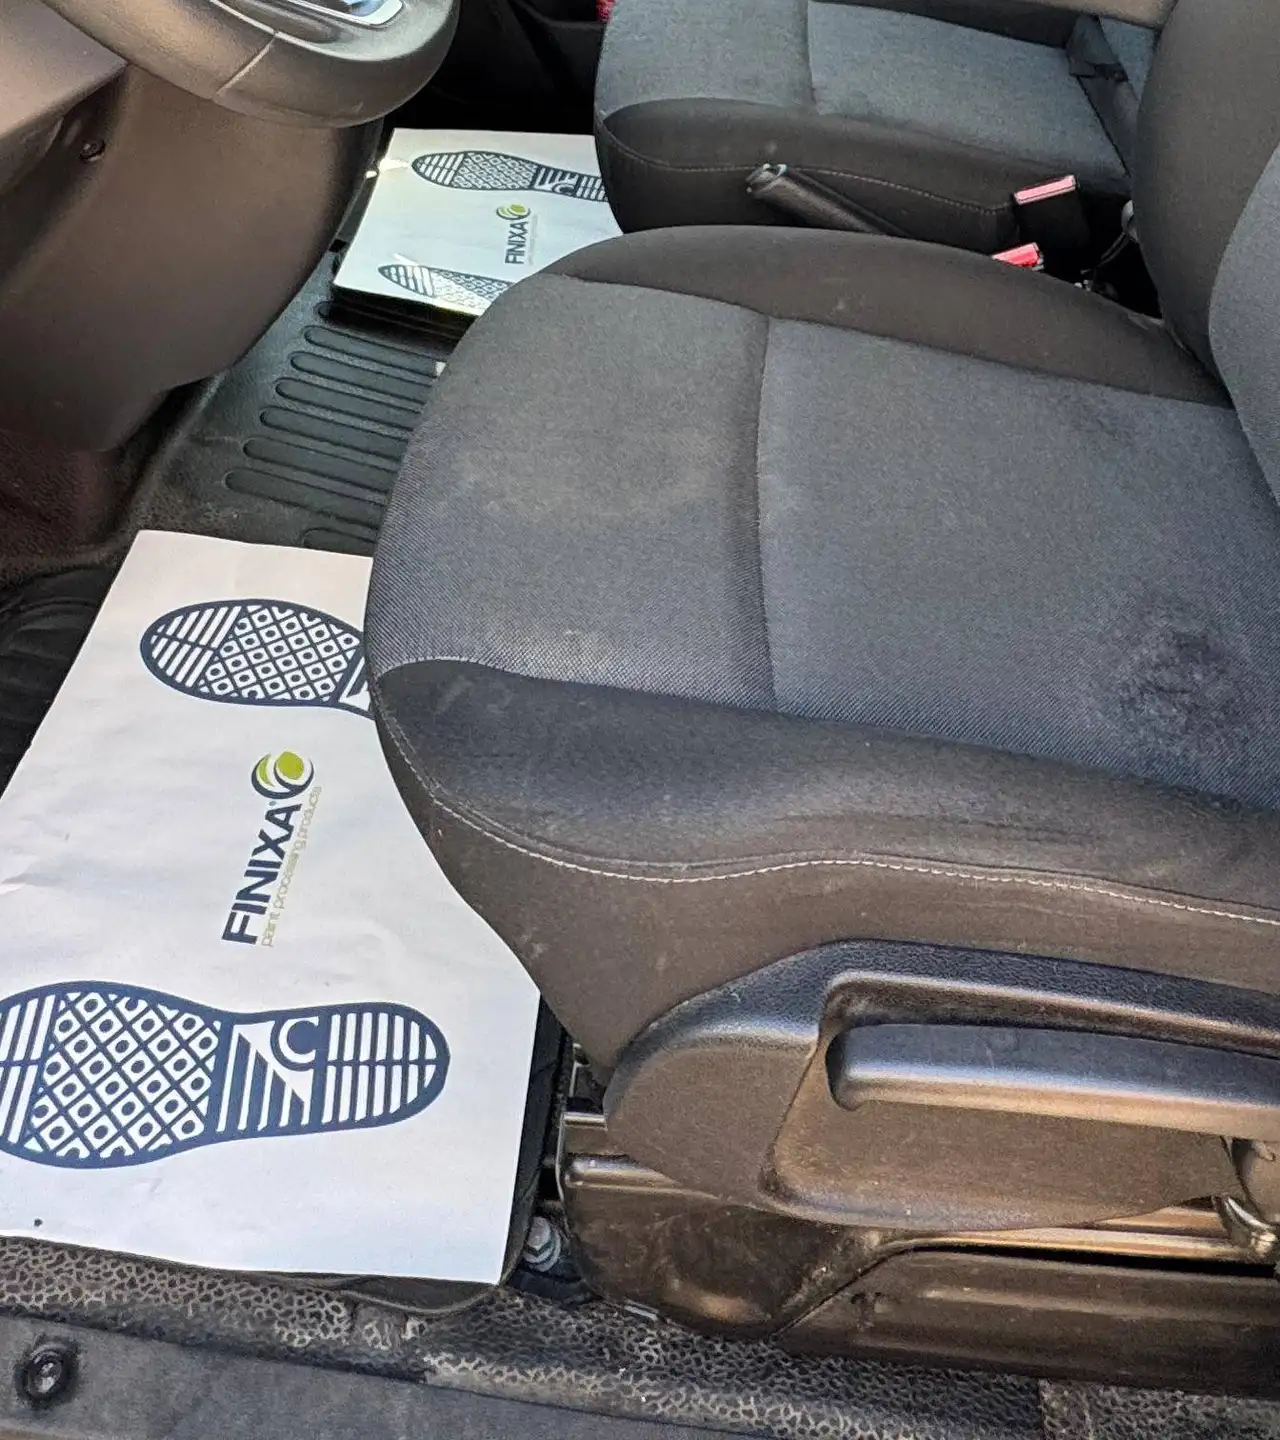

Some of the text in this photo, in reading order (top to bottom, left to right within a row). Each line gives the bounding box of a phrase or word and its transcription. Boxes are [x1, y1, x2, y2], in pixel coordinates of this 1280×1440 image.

[504, 221, 529, 264] FINIXA
[221, 803, 303, 946] FINIXA
[261, 785, 323, 948] paint processing products
